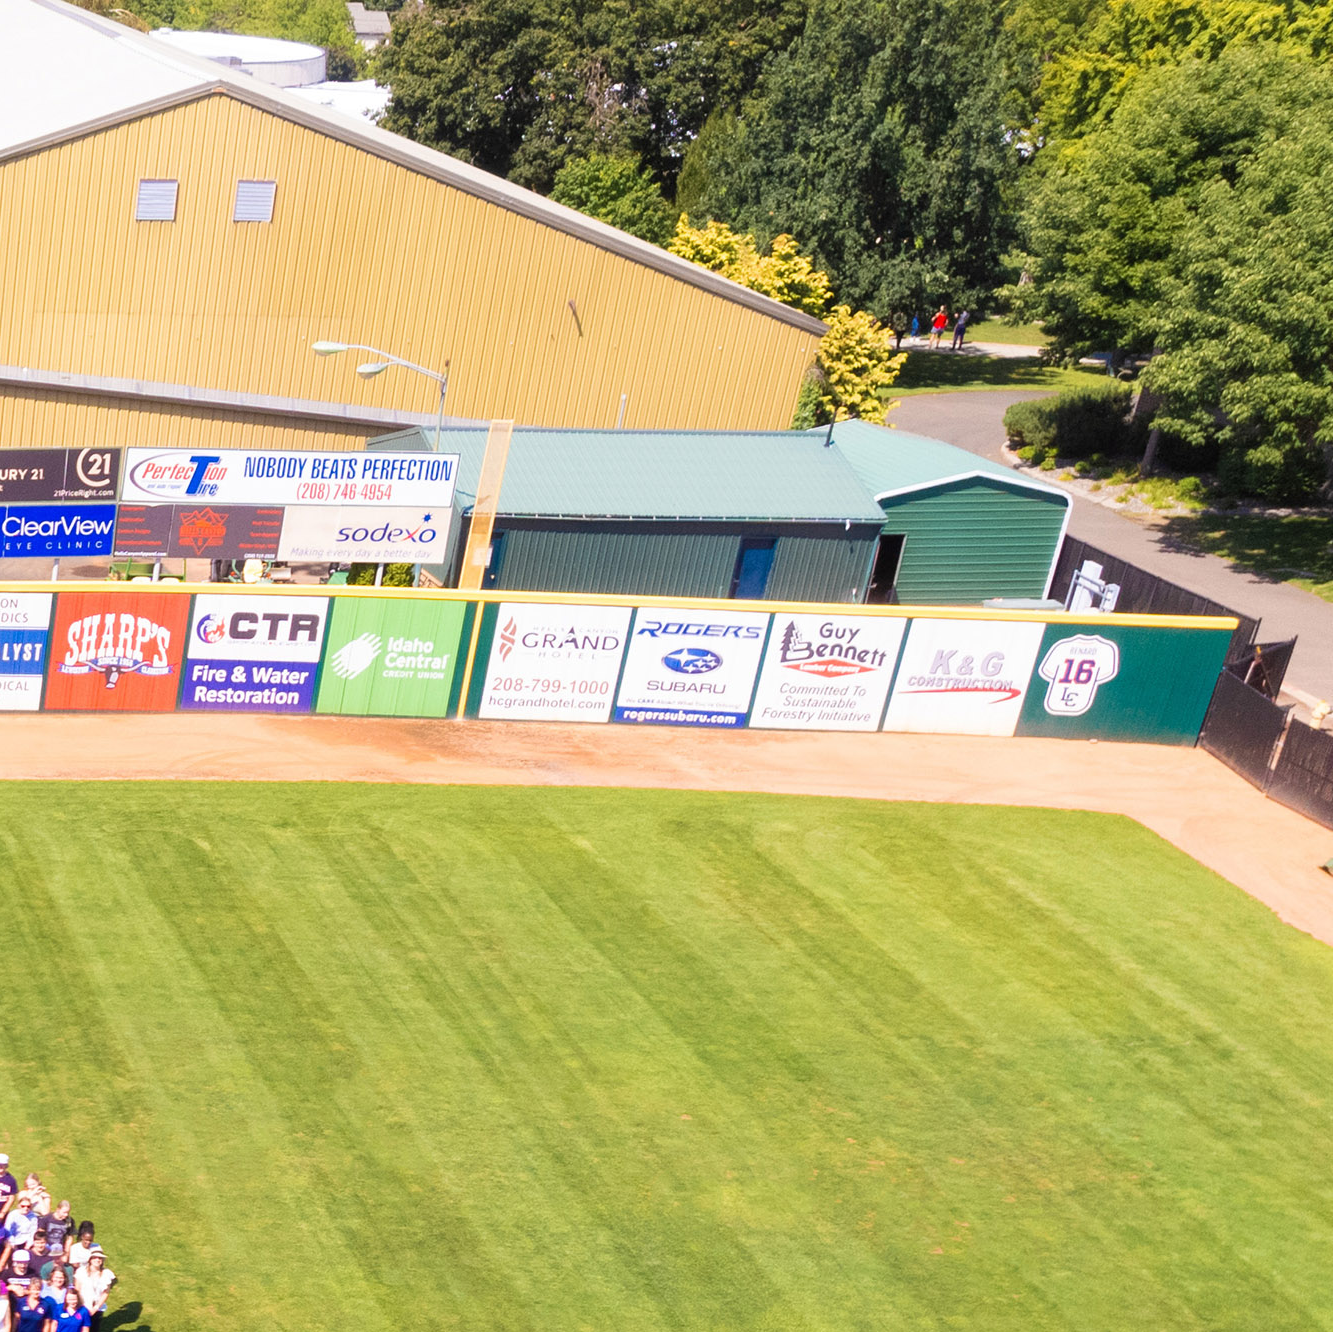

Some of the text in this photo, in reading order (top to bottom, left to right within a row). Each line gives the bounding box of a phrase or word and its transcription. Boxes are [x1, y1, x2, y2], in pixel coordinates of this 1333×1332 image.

[30, 468, 44, 480] 21
[244, 456, 453, 481] NOBODY BEATS PERFECTION
[297, 482, 330, 501] (208)
[2, 516, 113, 537] ClearView
[336, 522, 437, 544] sodexo
[5, 541, 103, 550] EYE CLINIC
[229, 611, 320, 642] CTR
[636, 621, 764, 640] ROGERS
[819, 622, 861, 643] Guy
[64, 612, 172, 668] SHARP'S
[387, 637, 433, 653] Idaho
[521, 627, 620, 652] GRAND
[384, 653, 448, 671] Central
[781, 641, 888, 667] Bennett
[929, 649, 1006, 678] K & G
[192, 664, 309, 686] Fire & Water
[382, 670, 445, 679] CREDIT UNION
[1058, 658, 1096, 685] 16
[492, 676, 610, 696] 208-799-1000
[647, 680, 727, 695] SUBARU
[779, 682, 867, 697] Committed To
[907, 677, 1014, 692] CONSTRUCTION
[194, 686, 300, 706] Restoration
[488, 696, 606, 711] hcgrandhotel.com
[783, 695, 857, 710] Sustainable
[623, 709, 737, 725] rogerssubaru.com
[761, 707, 872, 726] Forestry Initiative
